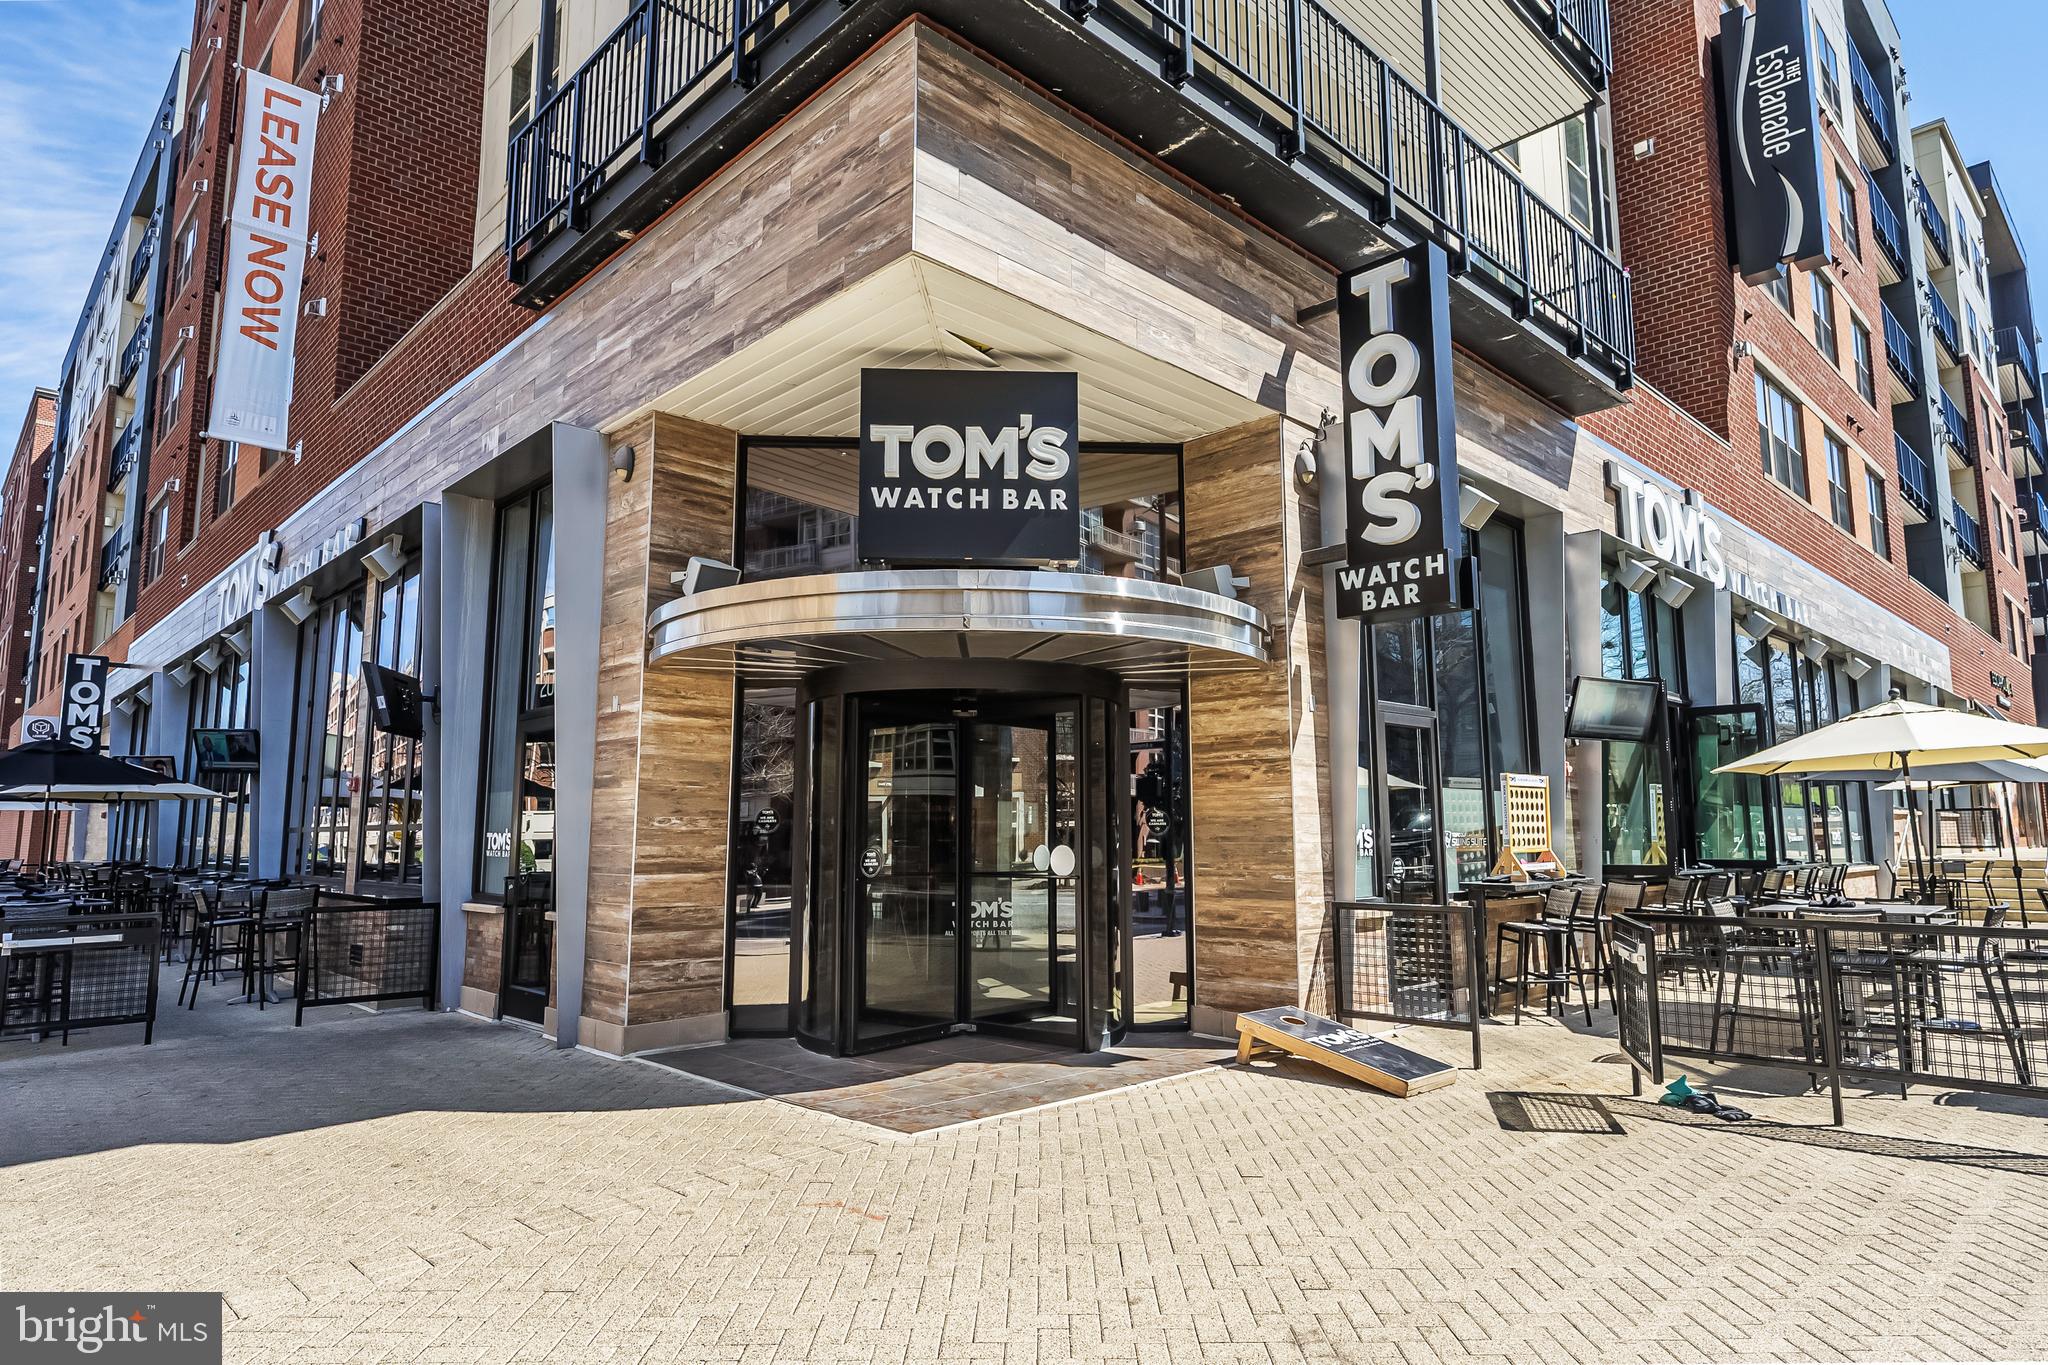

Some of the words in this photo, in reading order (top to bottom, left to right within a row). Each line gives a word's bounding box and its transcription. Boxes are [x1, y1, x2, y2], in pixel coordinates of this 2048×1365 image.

[1749, 44, 1806, 158] Esplanade
[1785, 56, 1800, 79] THE
[252, 87, 302, 228] LEASE
[240, 232, 288, 350] NOW
[1348, 257, 1434, 546] TOM'S
[869, 413, 1070, 481] TOM'S
[870, 486, 989, 510] WATCH
[1002, 488, 1068, 511] BAR
[1604, 460, 1726, 590] TOM'S
[217, 529, 282, 631] TOM'S
[1339, 553, 1445, 592] WATCH
[1361, 582, 1421, 612] BAR
[486, 828, 511, 851] TOM'S
